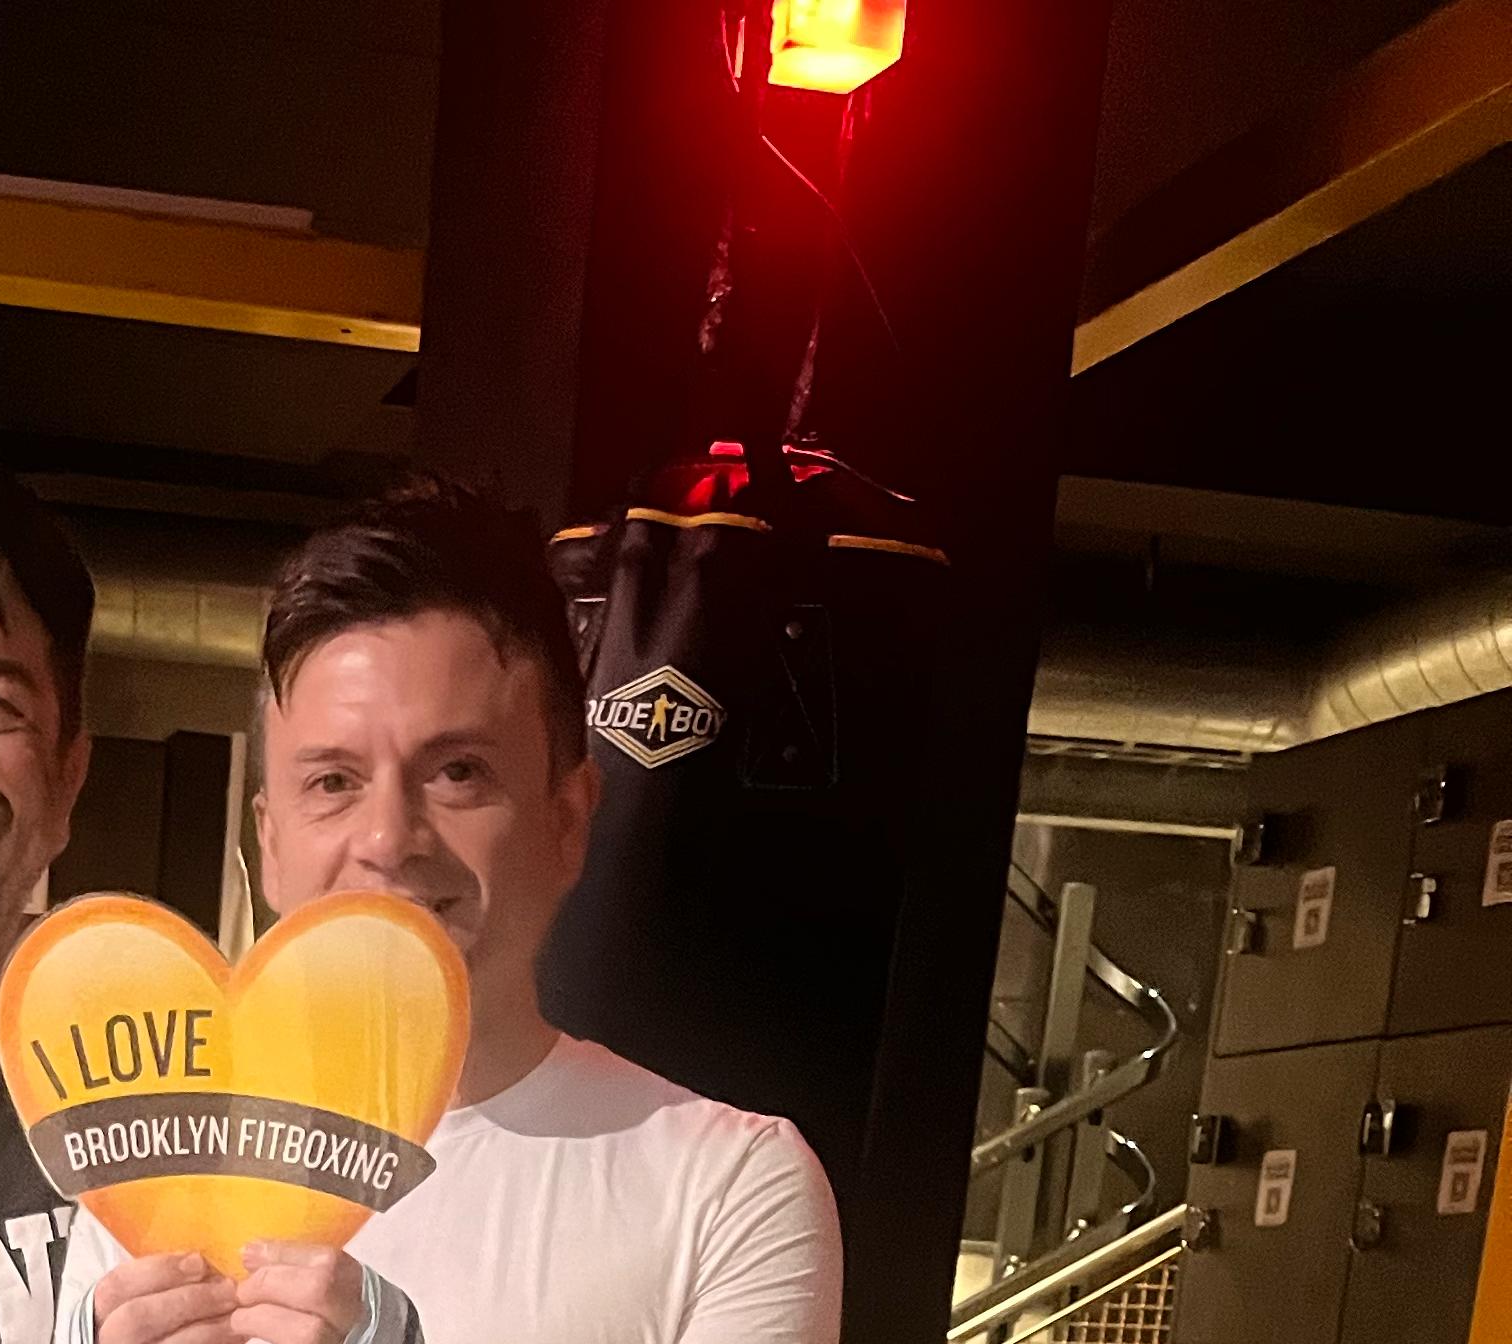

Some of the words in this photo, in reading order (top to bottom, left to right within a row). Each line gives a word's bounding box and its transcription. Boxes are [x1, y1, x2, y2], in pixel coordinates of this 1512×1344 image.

[31, 1040, 67, 1100] I
[70, 1009, 213, 1091] LOVE
[64, 1115, 229, 1172] BROOKLYN
[237, 1117, 400, 1190] FITBOXING
